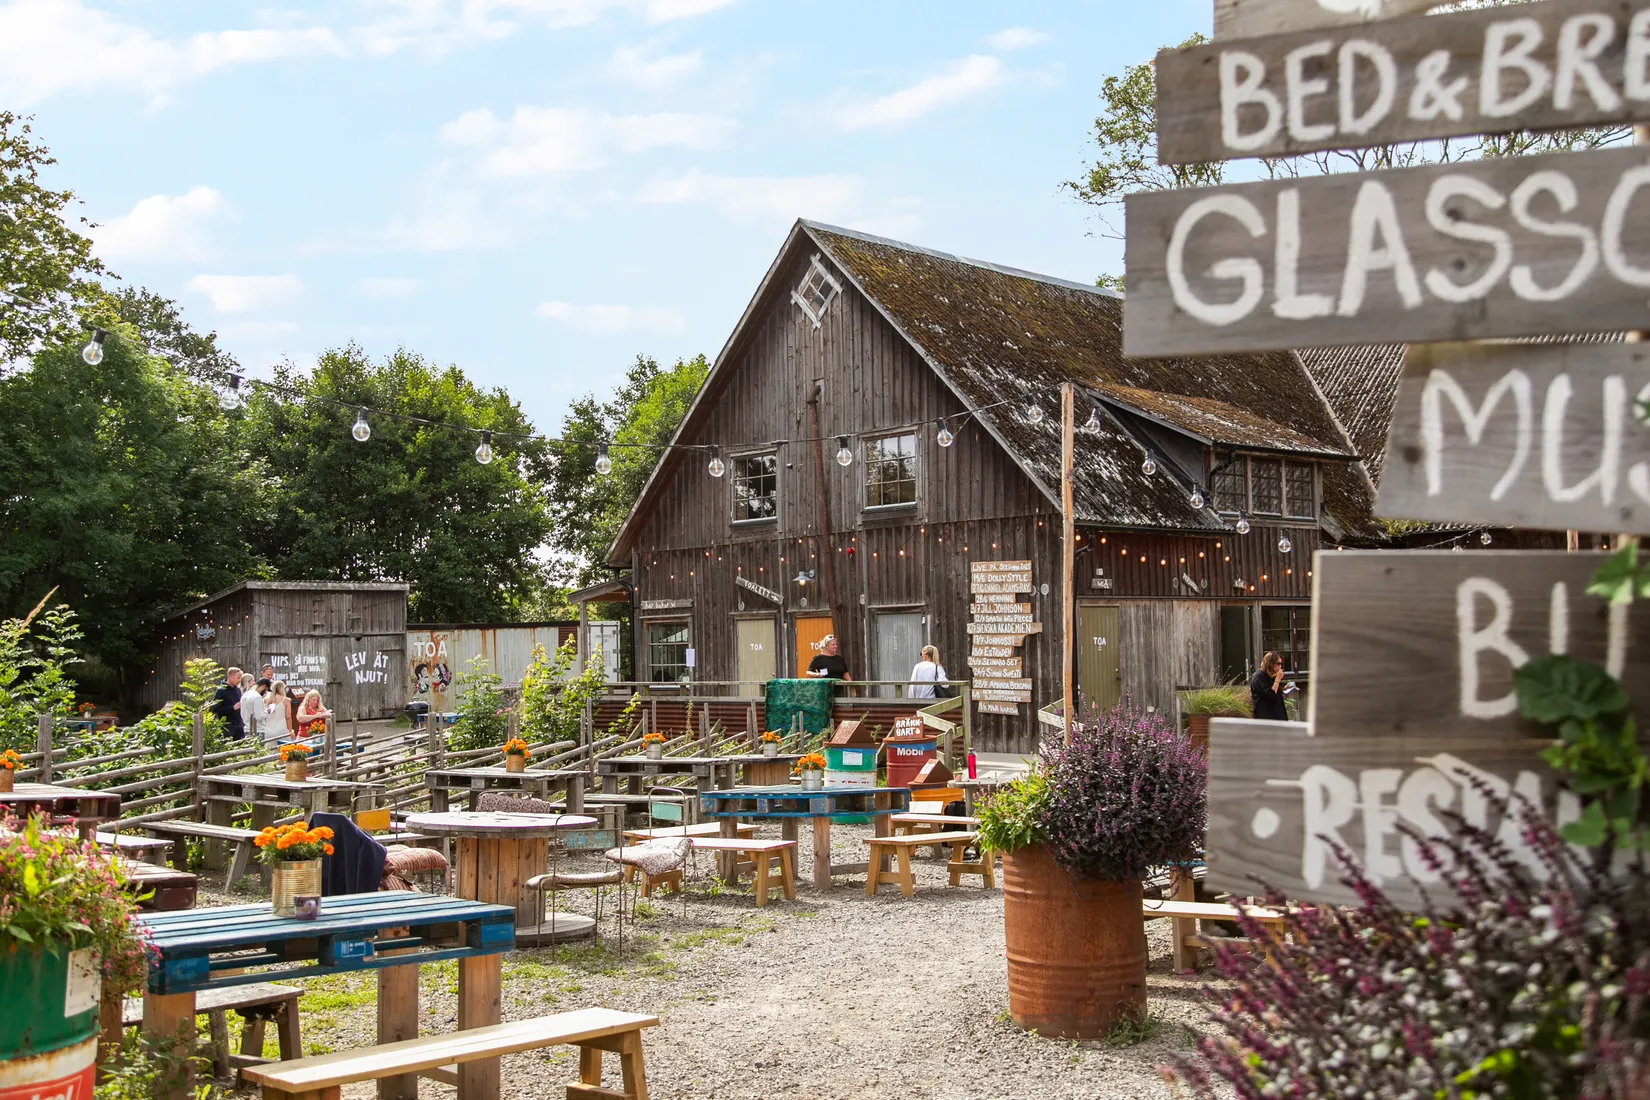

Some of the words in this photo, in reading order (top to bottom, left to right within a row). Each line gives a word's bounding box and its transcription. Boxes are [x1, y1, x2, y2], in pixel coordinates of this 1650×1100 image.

[1219, 39, 1396, 150] BED
[1408, 50, 1469, 120] &
[744, 580, 771, 598] TOALETT
[750, 643, 763, 651] TOA
[1093, 637, 1107, 645] TOA
[413, 641, 448, 657] TOA
[345, 651, 367, 671] LEV
[373, 651, 389, 669] ÄT
[355, 671, 388, 685] NJUT!
[896, 727, 915, 736] BART
